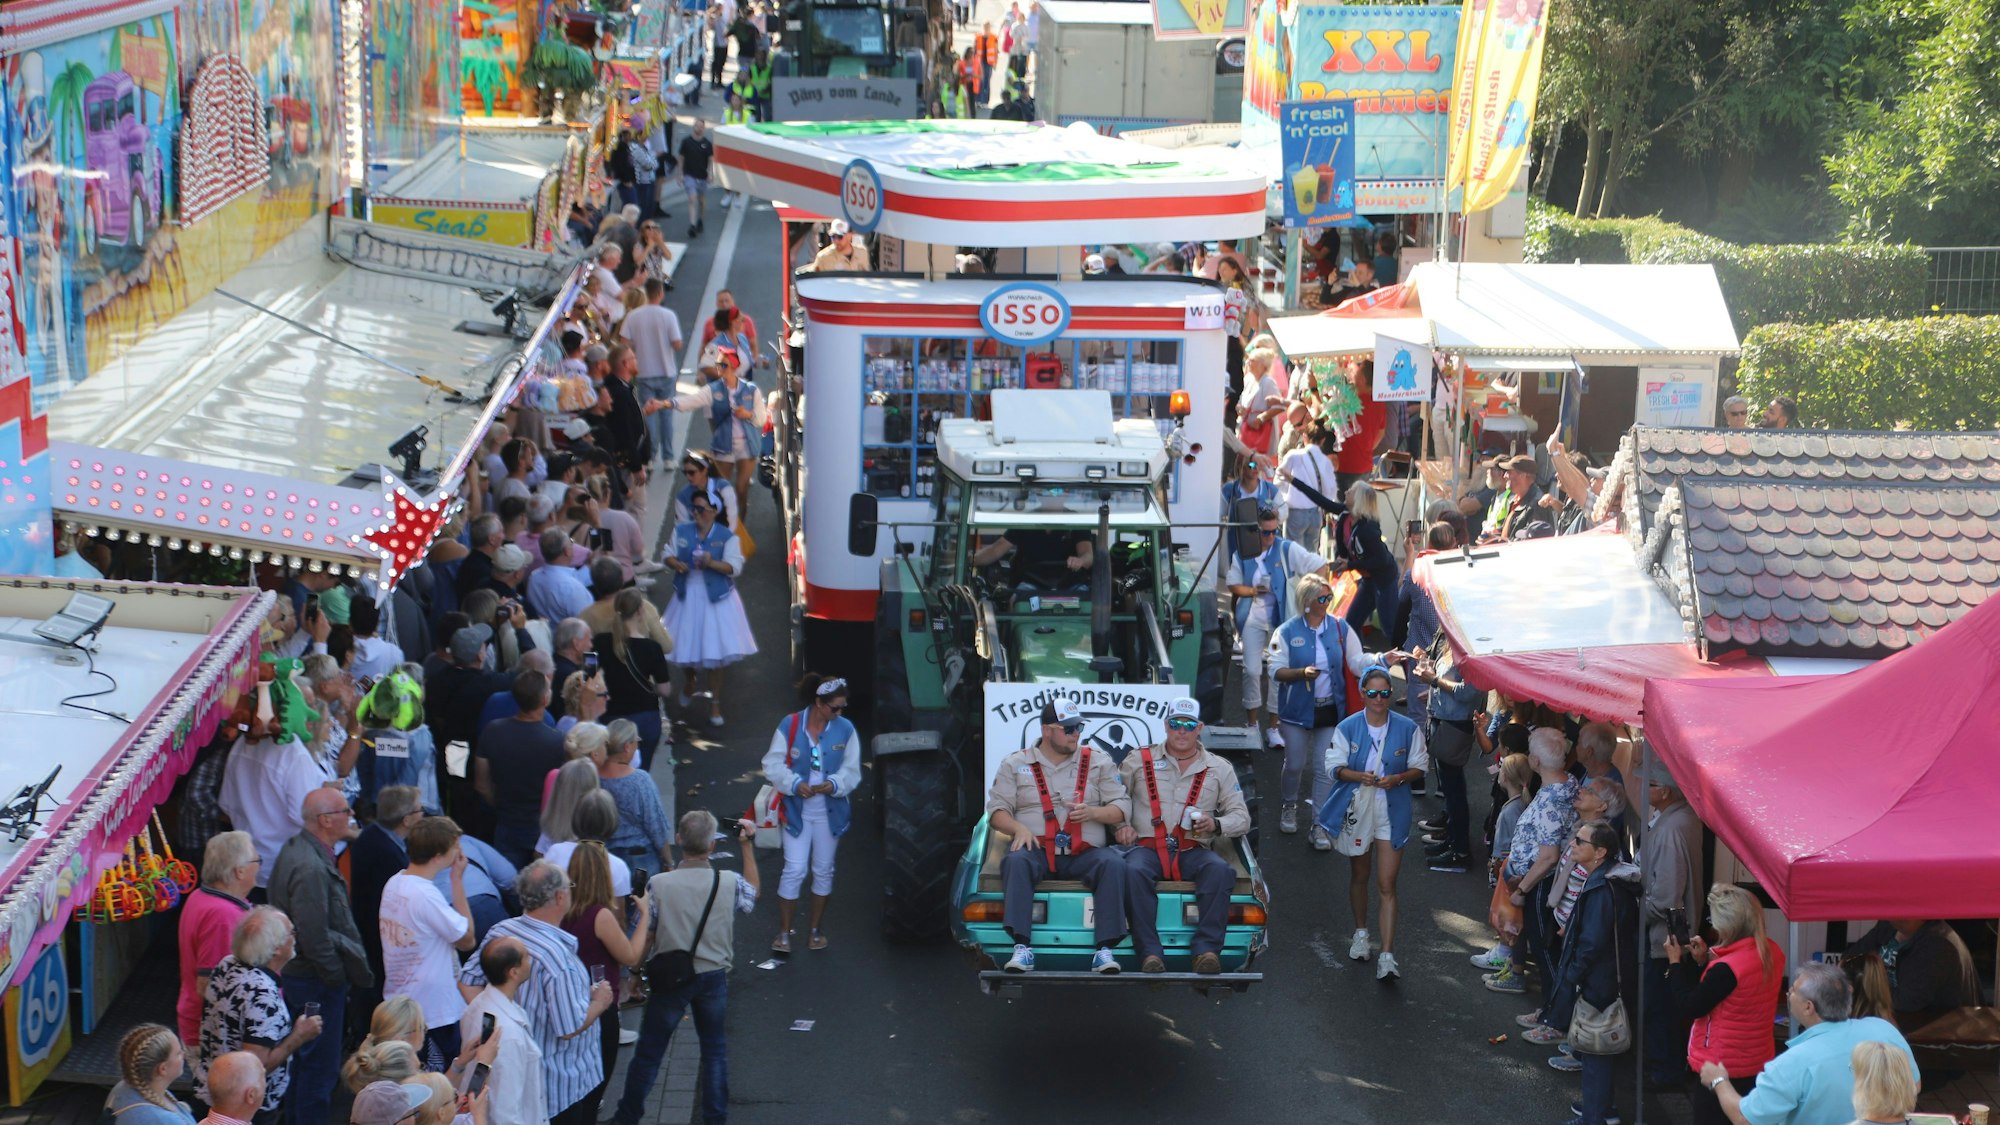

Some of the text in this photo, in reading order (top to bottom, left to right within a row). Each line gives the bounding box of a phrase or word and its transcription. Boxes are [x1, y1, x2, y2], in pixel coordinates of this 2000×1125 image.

[1321, 29, 1441, 73] XXL
[829, 86, 857, 99] vom
[864, 86, 902, 107] Lande
[1290, 106, 1345, 122] fresh
[1473, 69, 1501, 183] MonsterSlush
[845, 180, 876, 211] ISSO
[992, 303, 1060, 325] ISSO
[1190, 305, 1221, 317] W10
[27, 954, 60, 1044] 66
